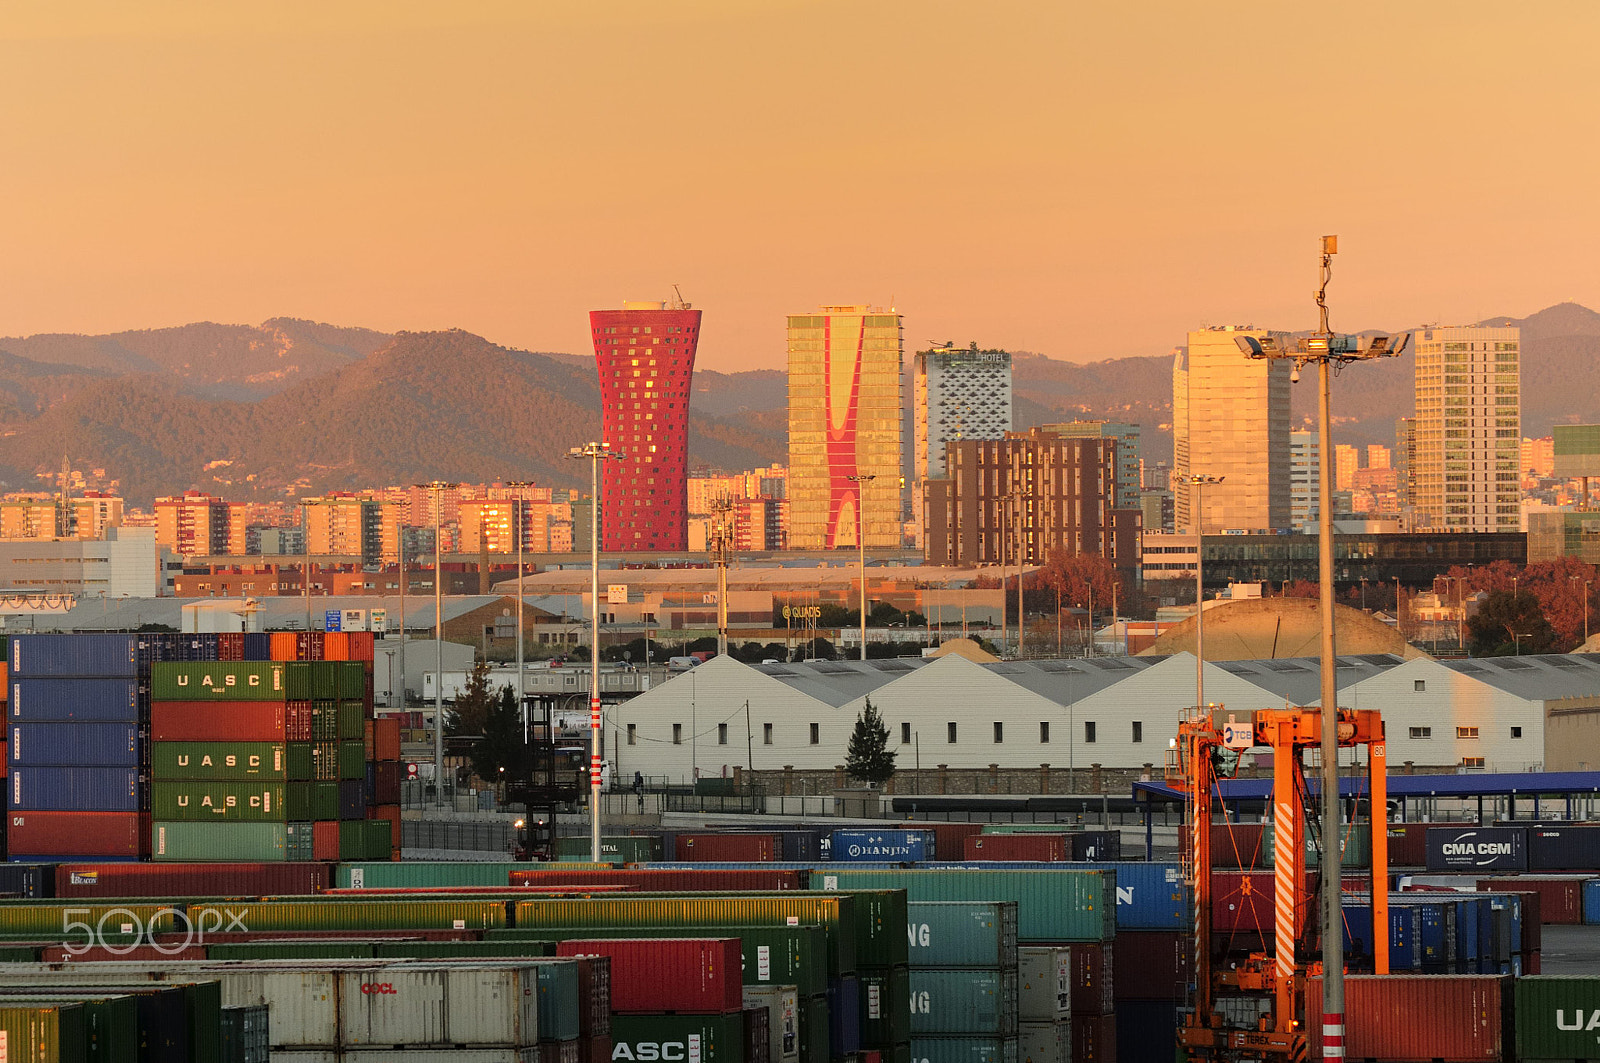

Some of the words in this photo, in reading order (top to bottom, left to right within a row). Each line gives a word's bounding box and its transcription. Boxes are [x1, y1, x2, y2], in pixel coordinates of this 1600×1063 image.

[981, 354, 1005, 362] HOTEL
[792, 606, 822, 618] QUADIS
[1235, 730, 1252, 740] TCB
[862, 846, 910, 856] HANJIN
[1442, 843, 1476, 855] CMA
[1477, 843, 1511, 855] CGM
[1246, 1035, 1269, 1045] TEREX
